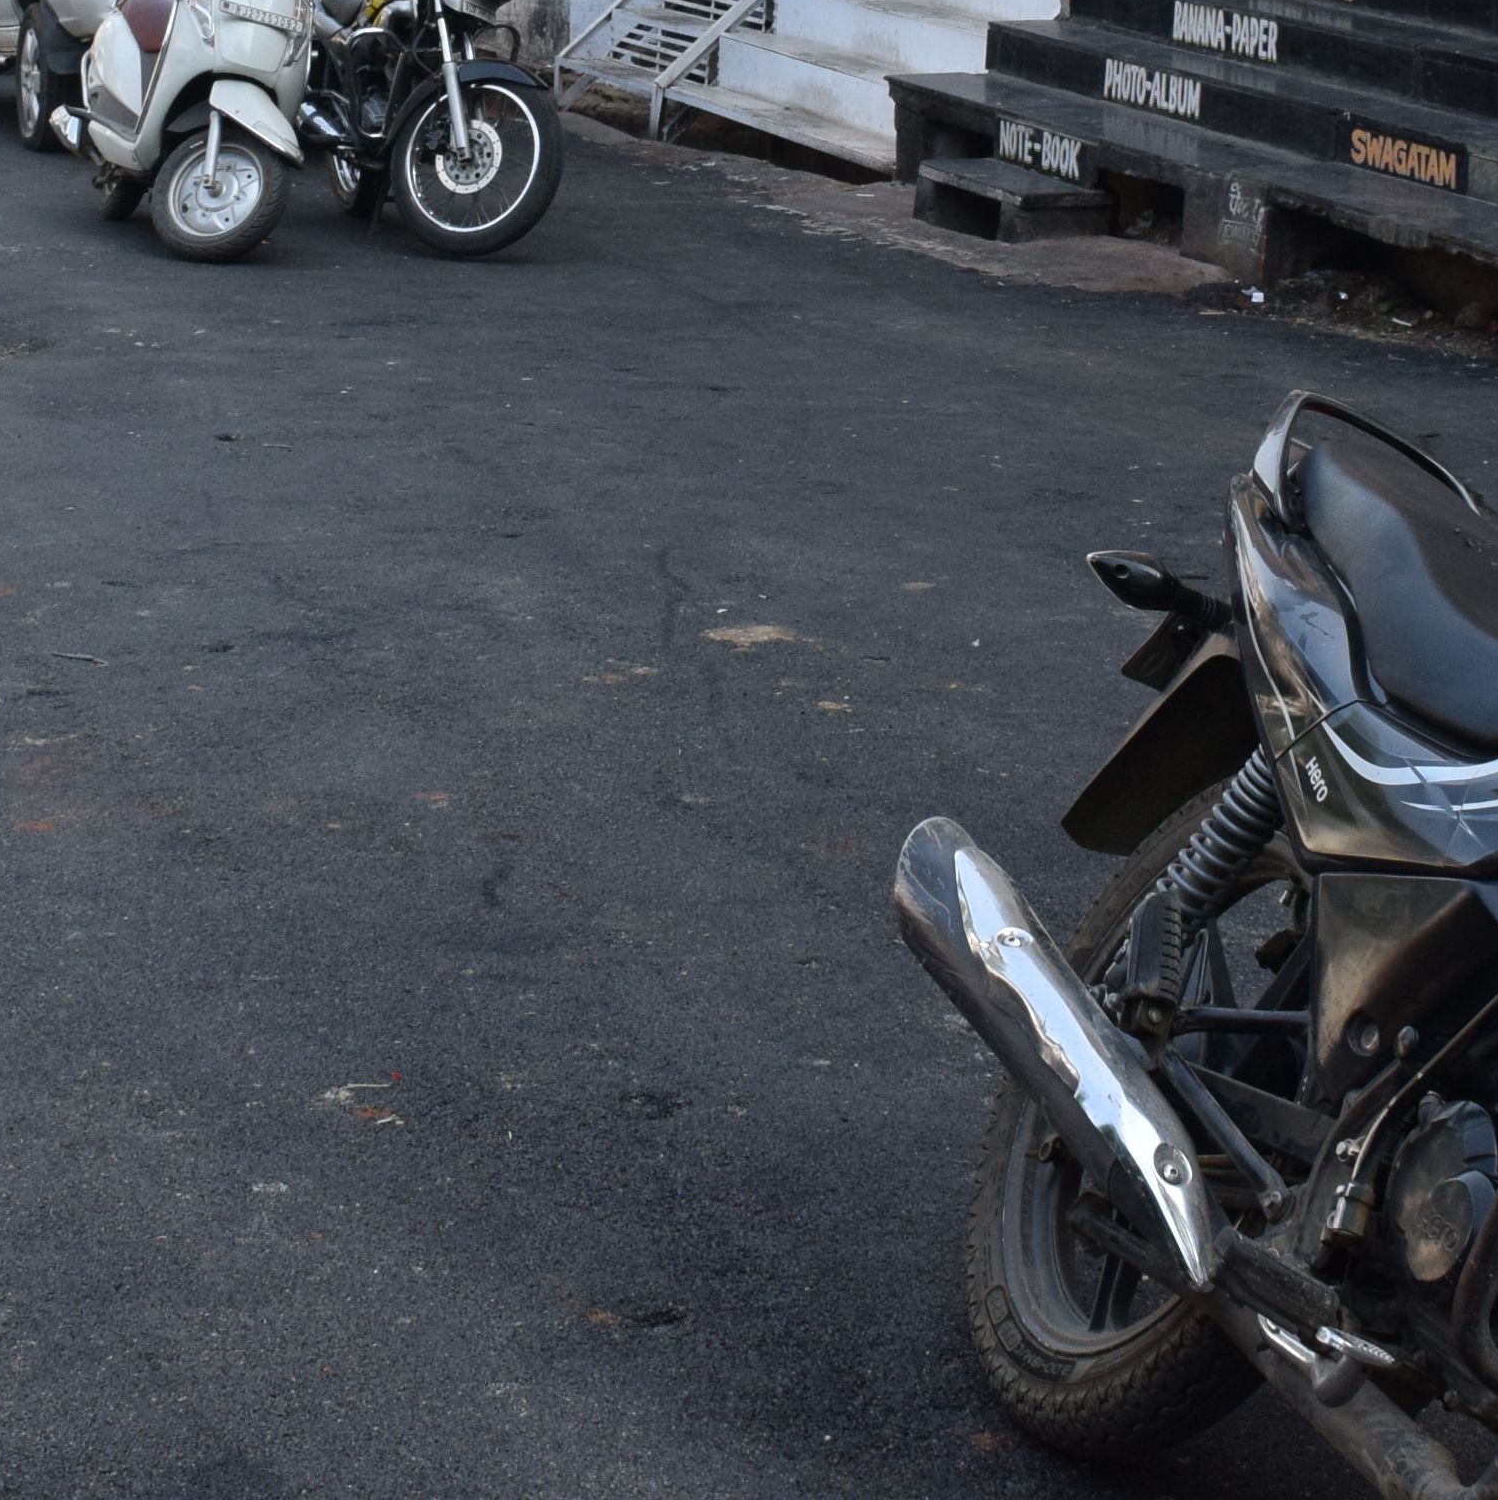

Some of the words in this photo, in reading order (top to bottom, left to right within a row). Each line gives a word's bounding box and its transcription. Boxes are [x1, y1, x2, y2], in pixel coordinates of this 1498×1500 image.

[1173, 0, 1278, 62] BANANA-PAPER
[1104, 59, 1201, 119] PHOTO-ALBUM
[1000, 119, 1081, 180] NOTE-BOOK
[1351, 129, 1457, 189] SWAGATAM
[1305, 756, 1329, 803] Hero
